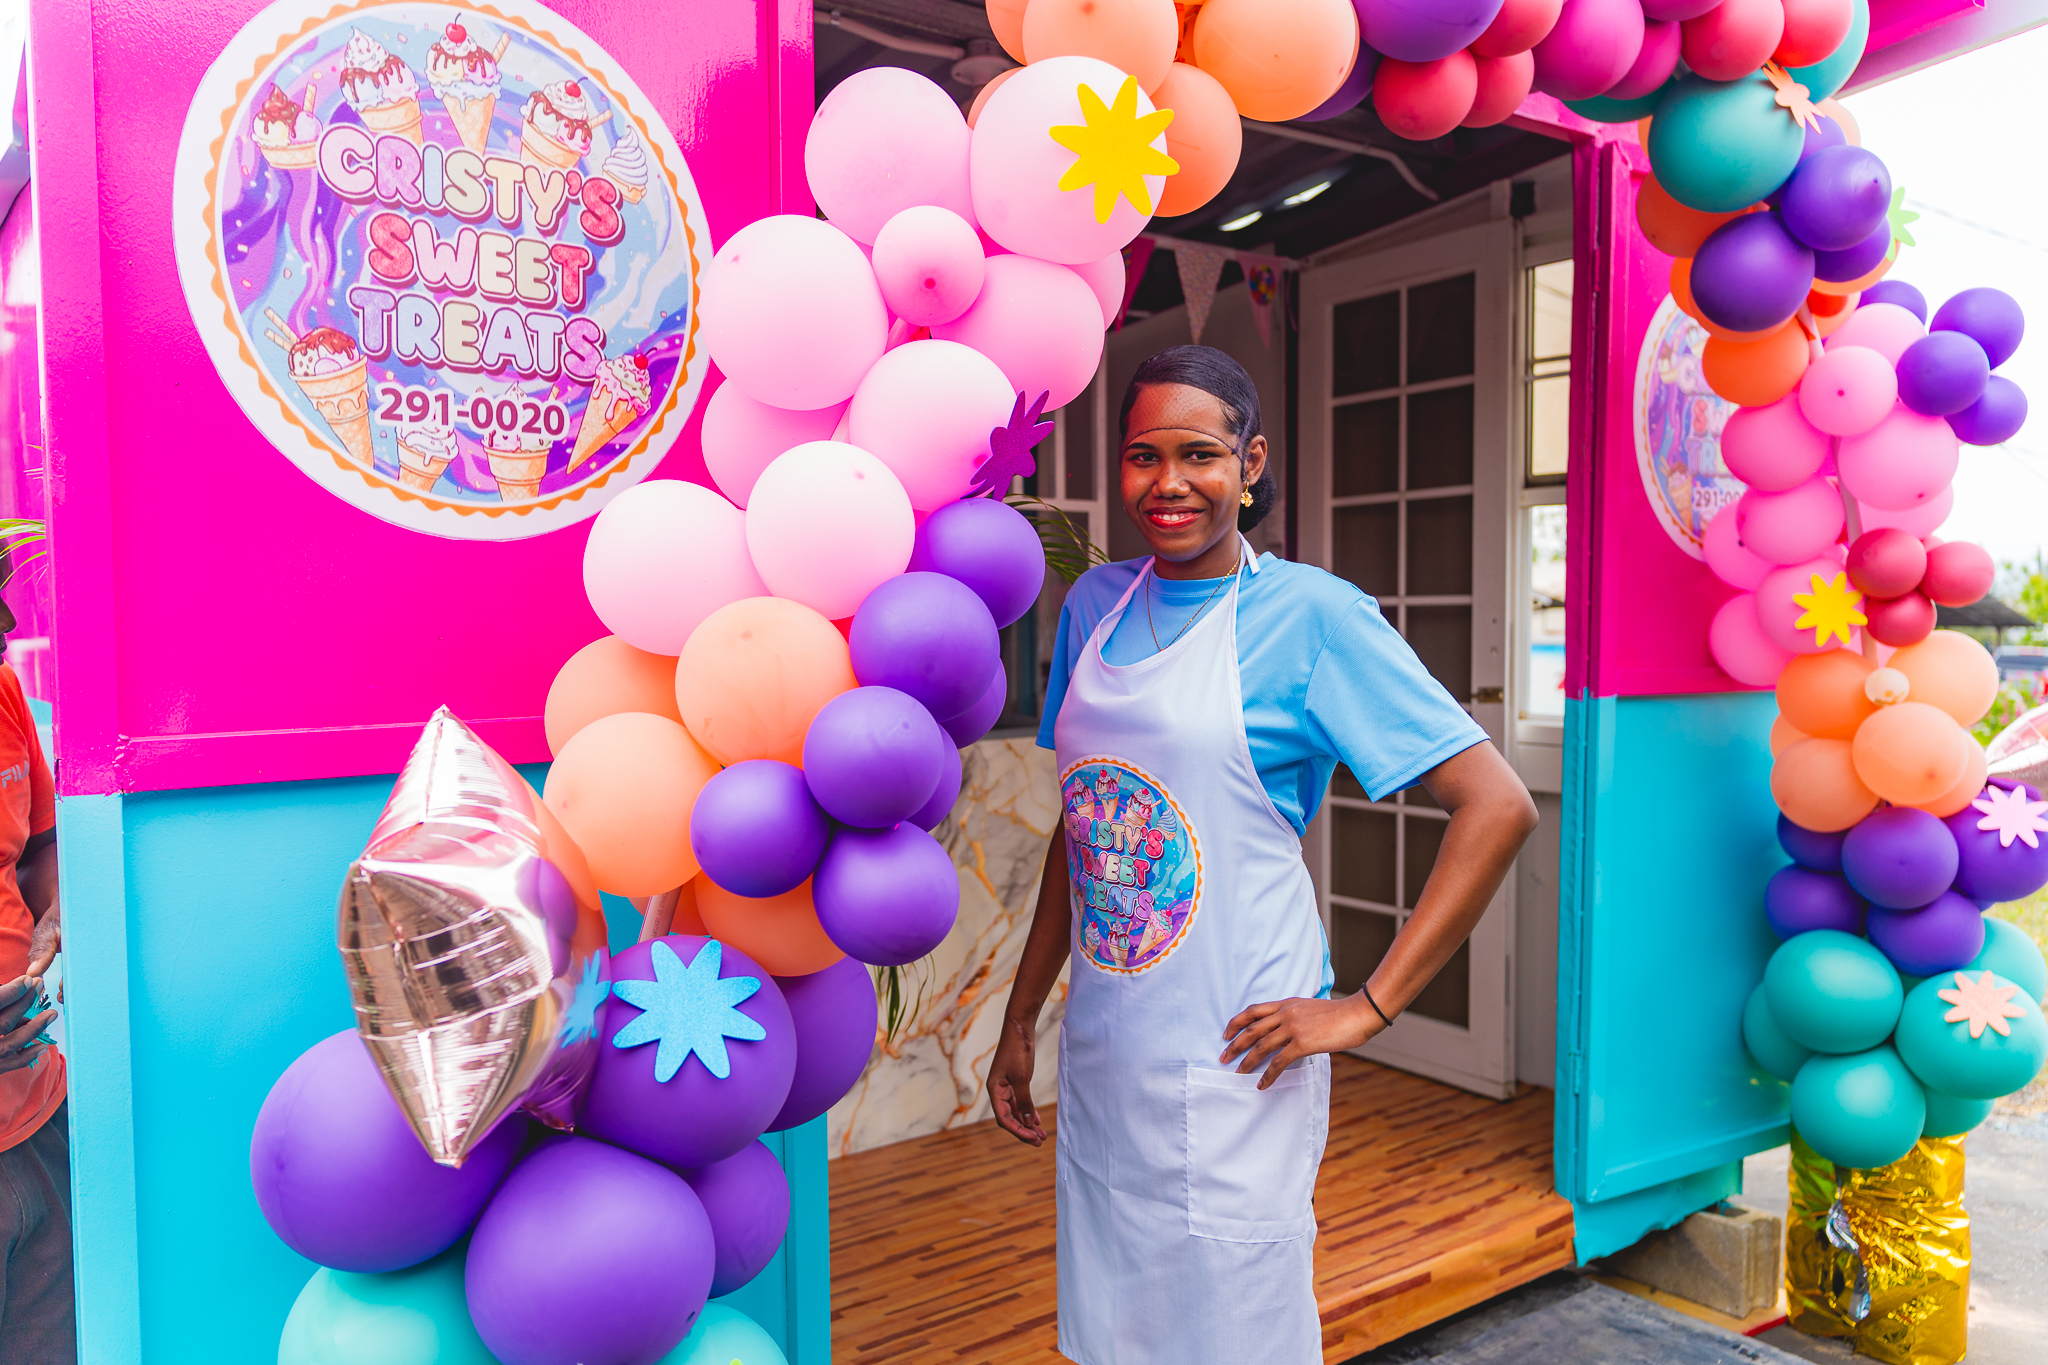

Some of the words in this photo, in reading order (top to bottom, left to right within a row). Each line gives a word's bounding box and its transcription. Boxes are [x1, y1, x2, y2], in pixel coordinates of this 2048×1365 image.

[318, 126, 624, 243] CRISTY'S
[368, 213, 592, 309] SWEET
[349, 287, 604, 382] TREATS
[379, 390, 566, 436] 291-0020
[1068, 813, 1164, 859] CRISTY'S
[1081, 846, 1150, 888] SWEET
